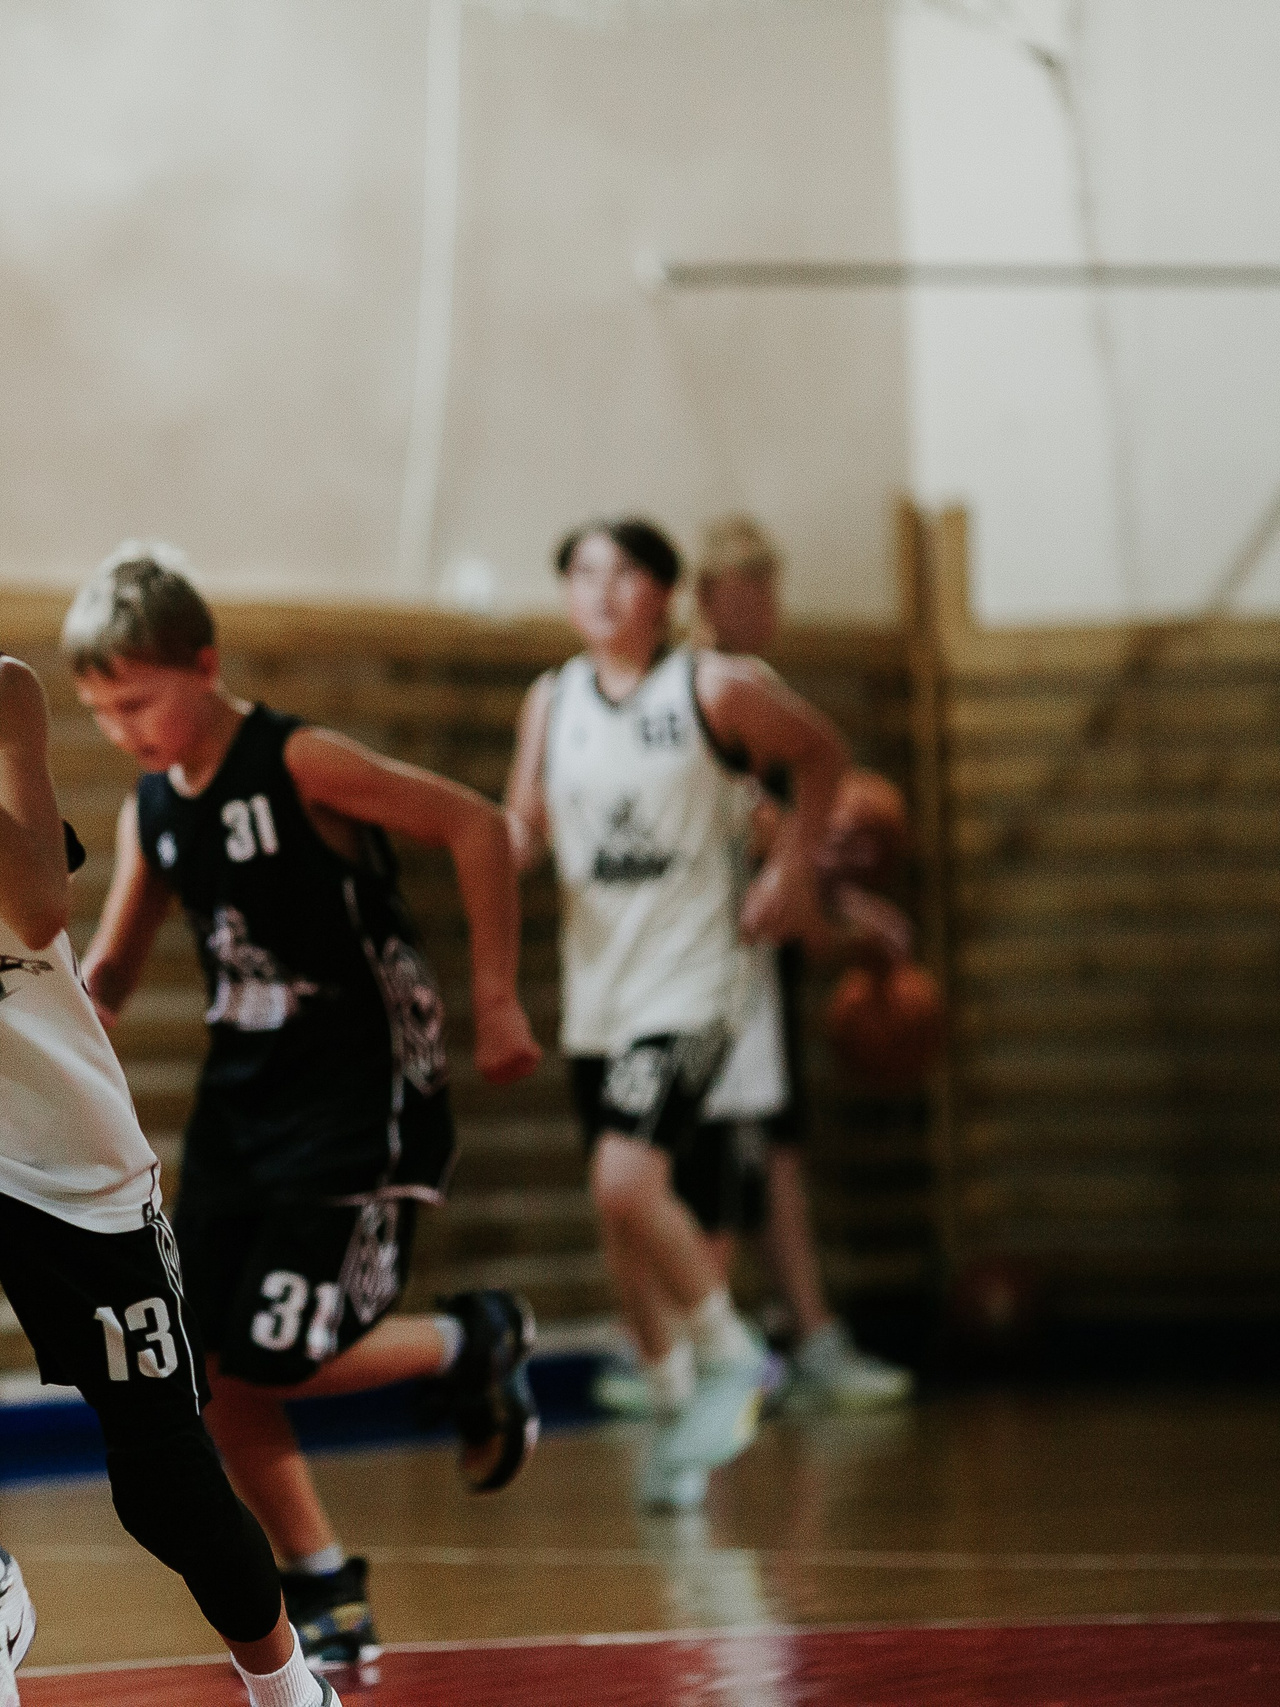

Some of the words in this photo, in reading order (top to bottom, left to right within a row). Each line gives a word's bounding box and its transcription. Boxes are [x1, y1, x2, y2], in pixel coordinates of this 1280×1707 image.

[221, 794, 278, 861] 31
[93, 1297, 179, 1381] 13
[251, 1270, 343, 1360] 31
